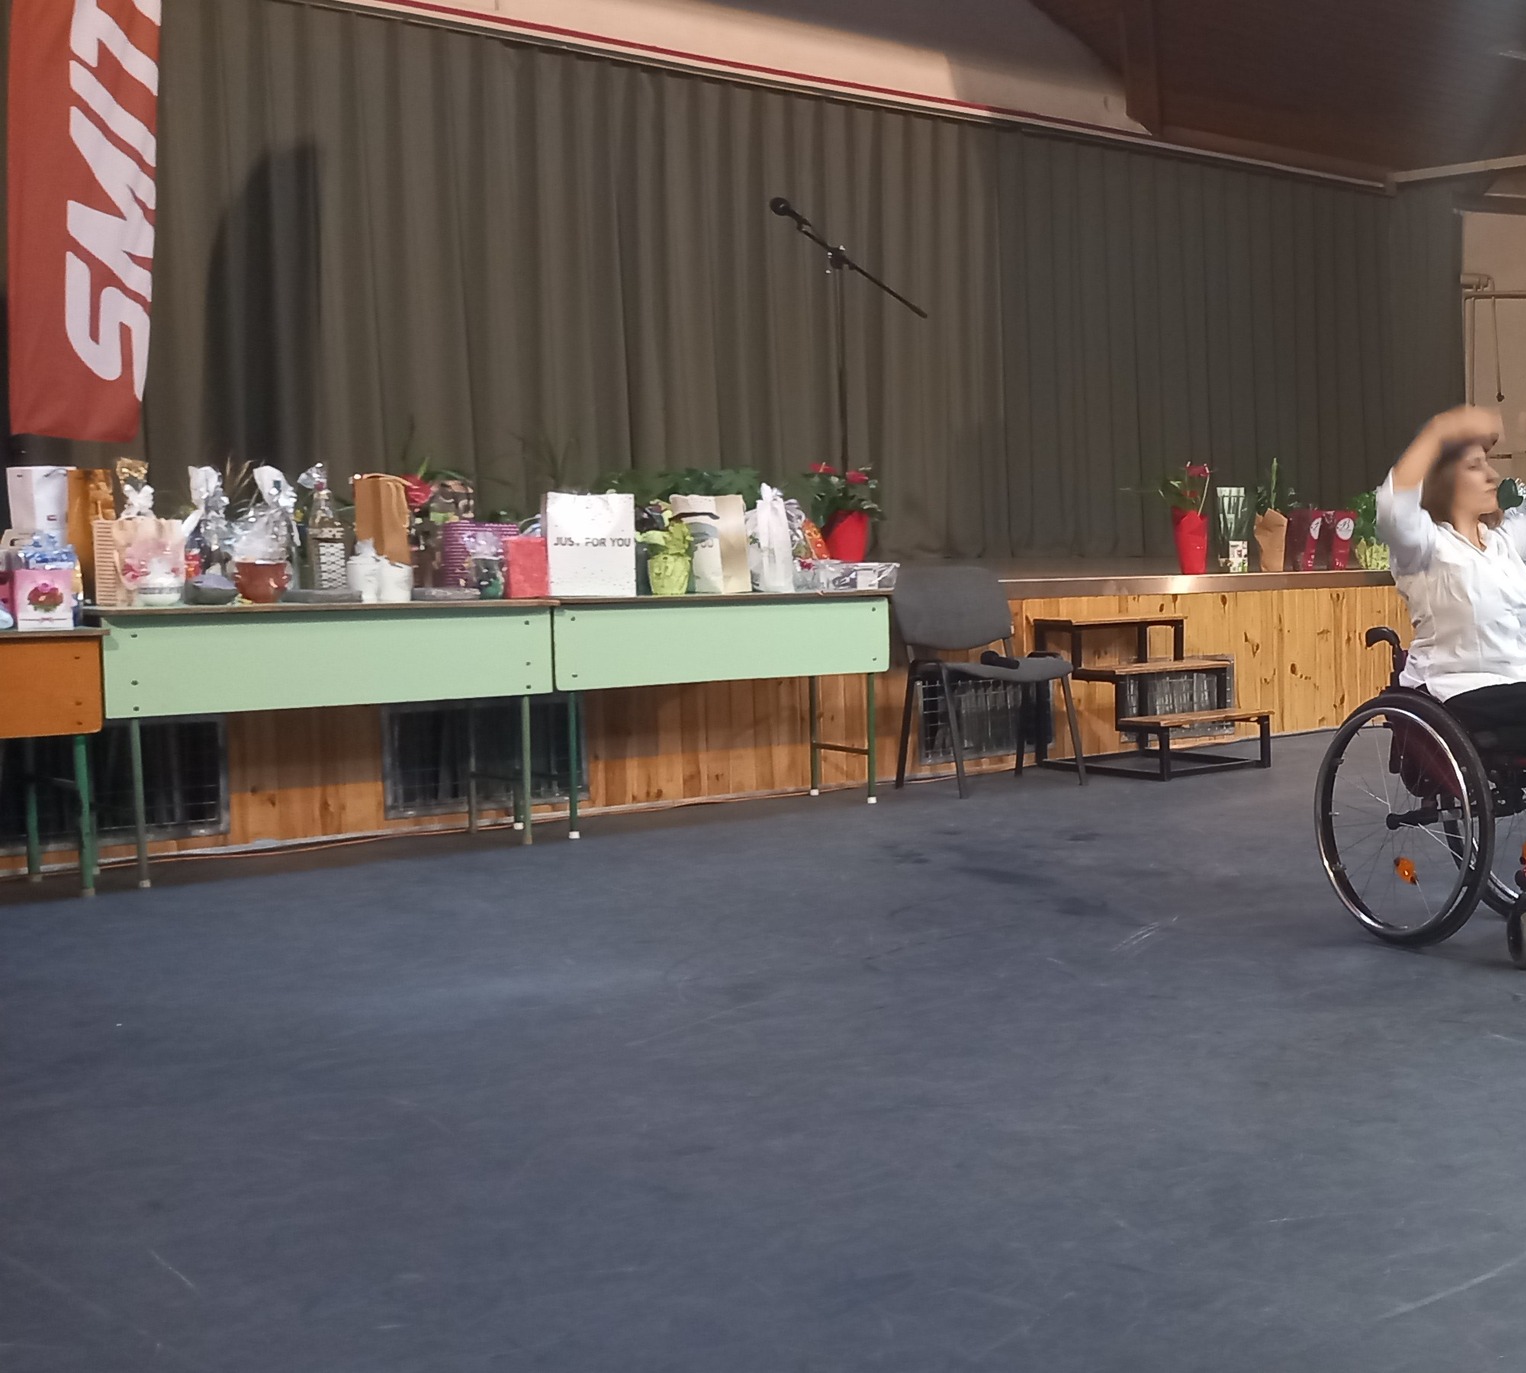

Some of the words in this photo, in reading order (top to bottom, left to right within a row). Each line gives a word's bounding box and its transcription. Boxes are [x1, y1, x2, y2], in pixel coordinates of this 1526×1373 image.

[65, 0, 162, 402] SMIT
[553, 536, 580, 547] JUS
[610, 537, 631, 547] YOU
